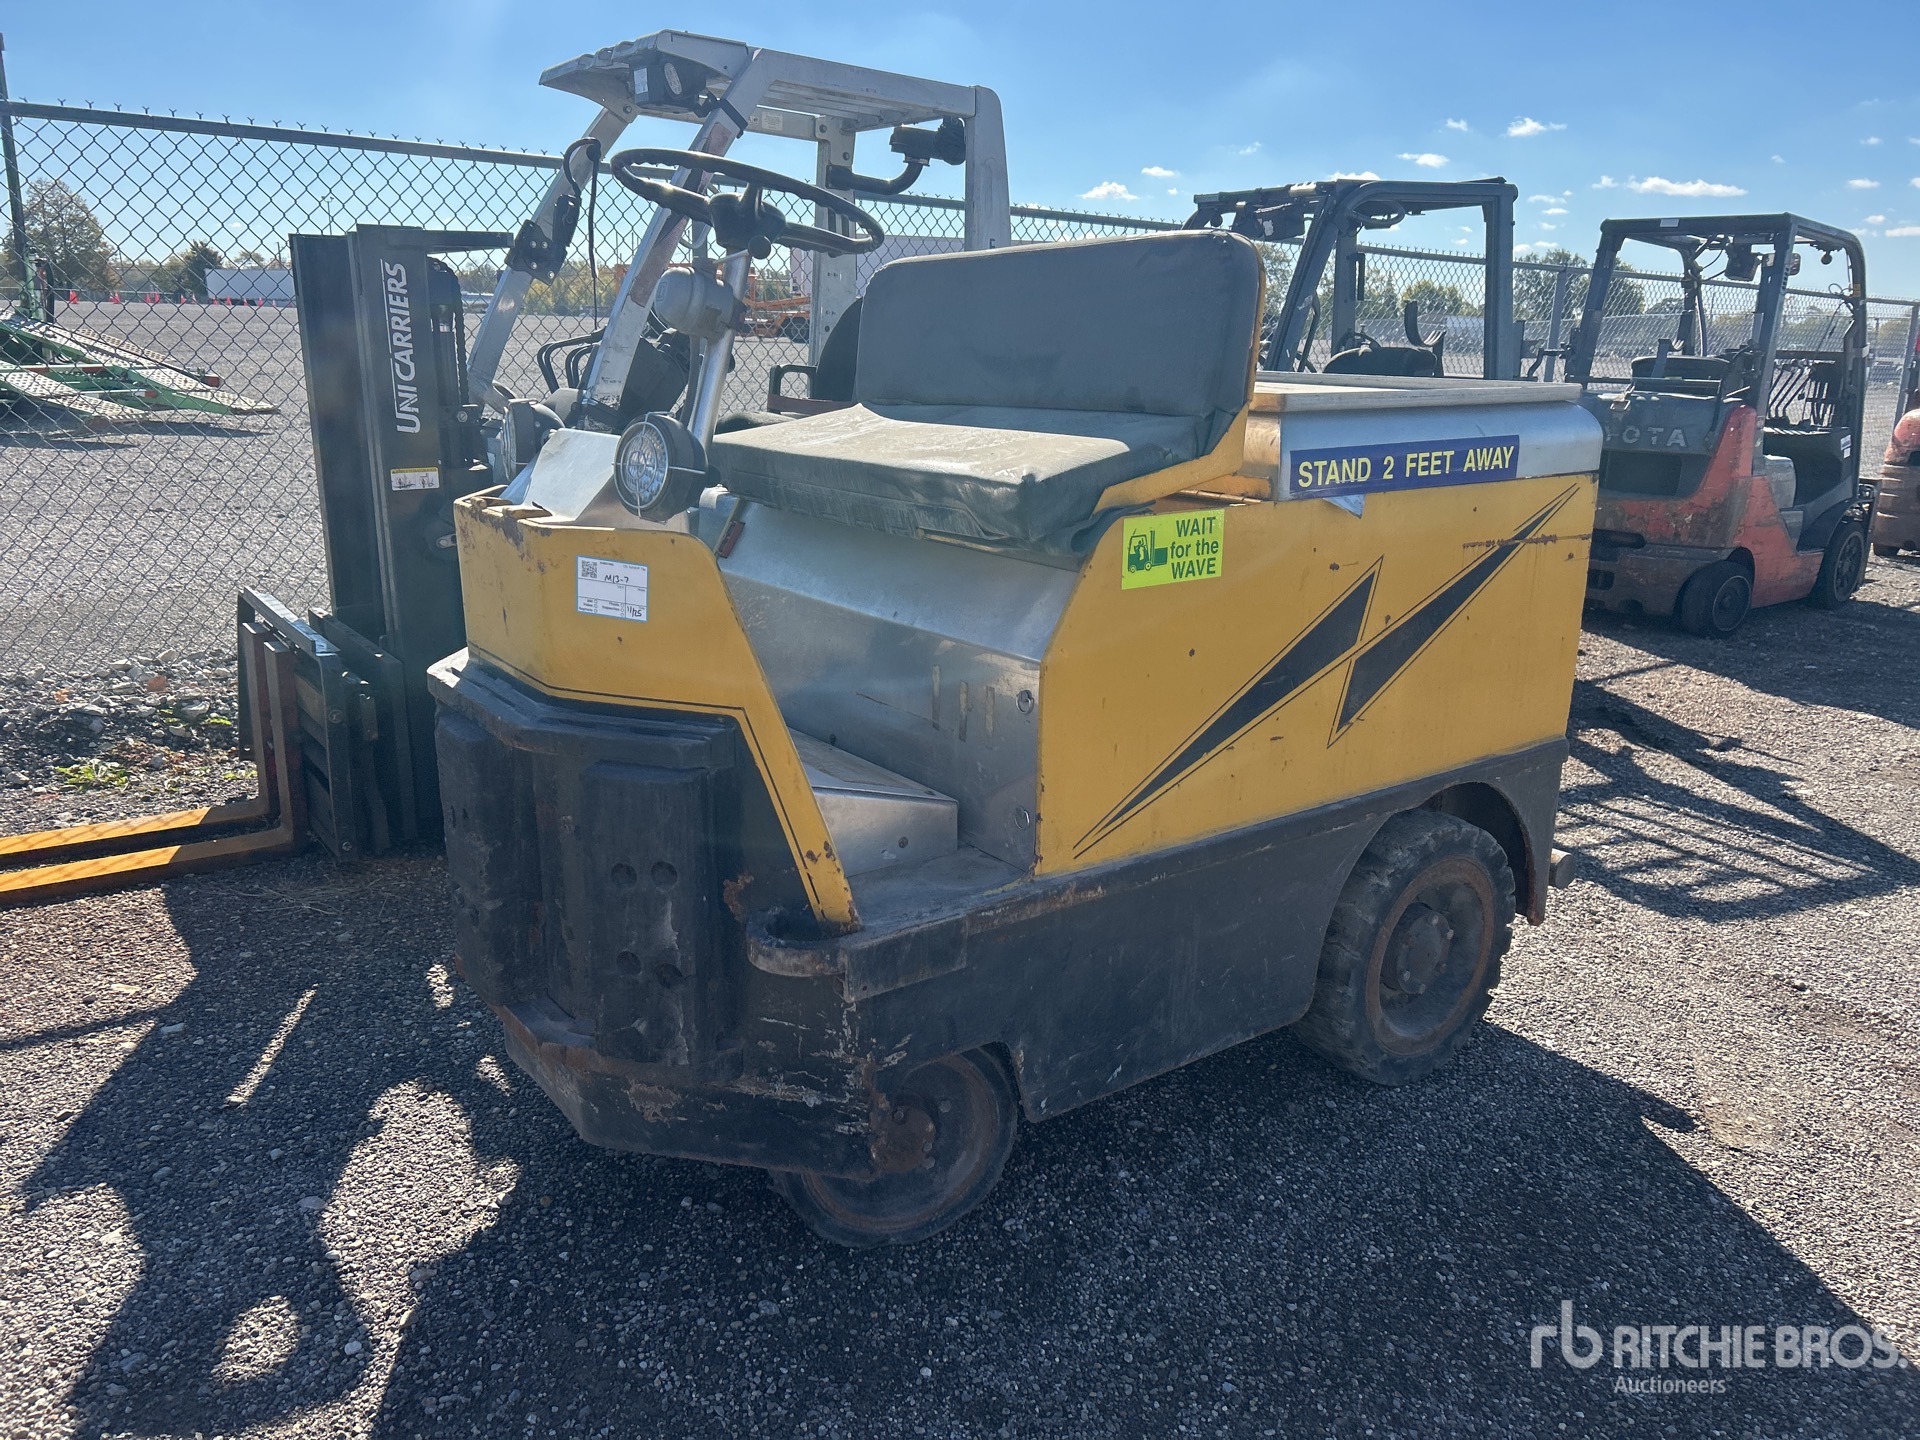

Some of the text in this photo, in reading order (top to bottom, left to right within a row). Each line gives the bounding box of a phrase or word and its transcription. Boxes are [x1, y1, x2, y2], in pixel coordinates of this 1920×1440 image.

[381, 259, 421, 434] UNICARRIERS
[1297, 445, 1515, 488] STAND 2 FEET AWAY
[1176, 516, 1216, 537] WAIT
[1170, 538, 1219, 559] for the
[1171, 557, 1216, 579] WAVE
